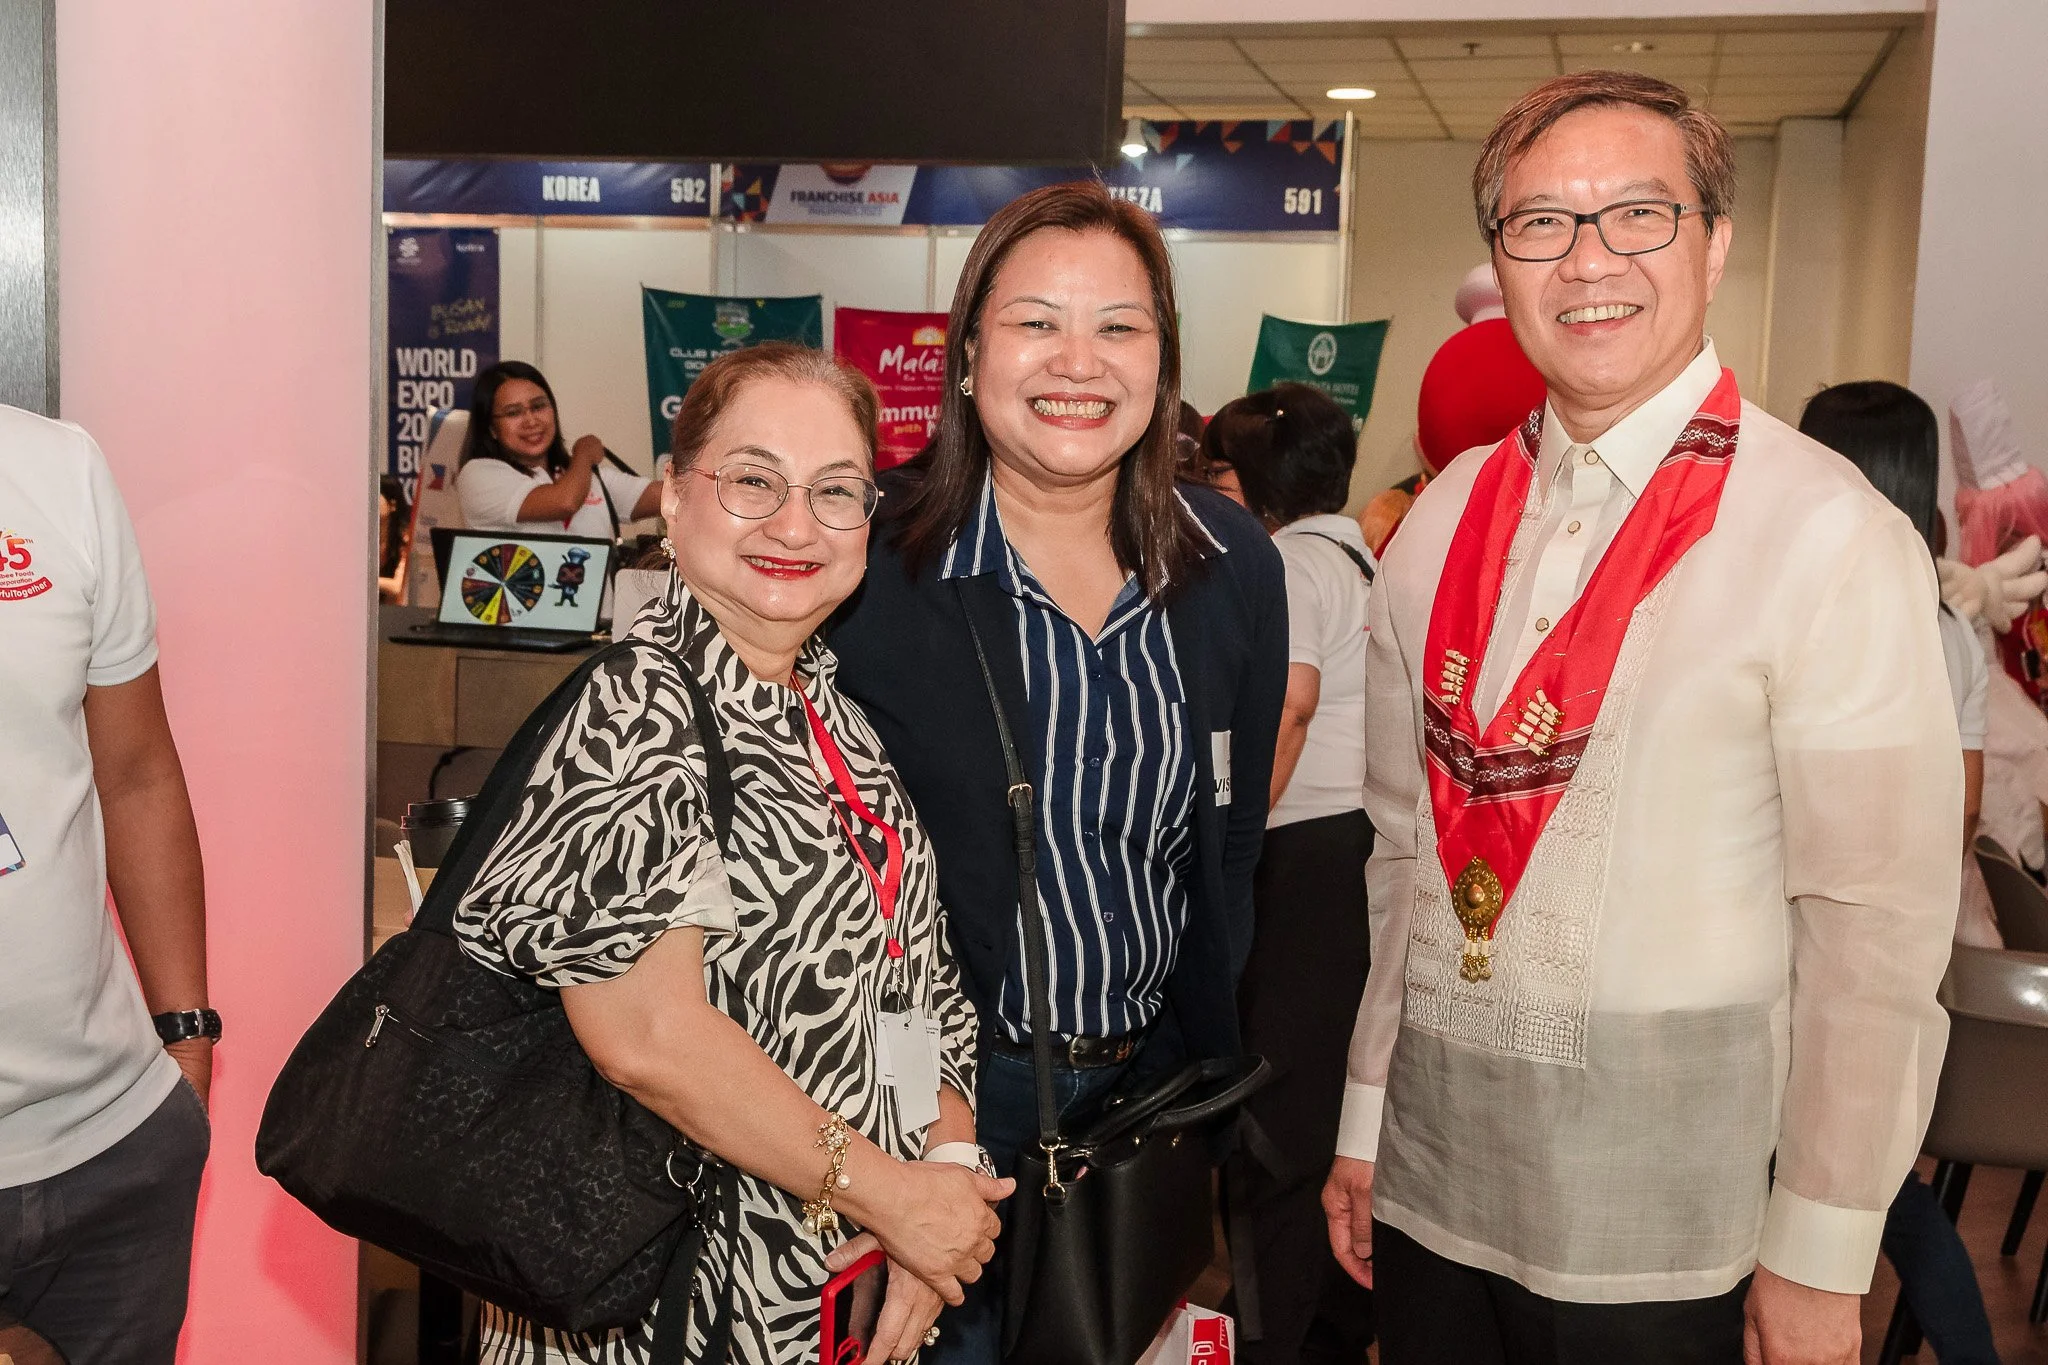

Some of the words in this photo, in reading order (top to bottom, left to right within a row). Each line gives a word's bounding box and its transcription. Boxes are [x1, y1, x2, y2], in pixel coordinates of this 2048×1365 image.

[542, 175, 600, 202] KOREA
[670, 177, 705, 203] 592
[791, 191, 864, 204] FRANCHISE
[867, 191, 899, 204] ASIA
[1284, 187, 1322, 215] 591
[396, 347, 478, 379] WORLD
[669, 346, 708, 359] CLUB
[879, 344, 939, 375] Mala
[397, 380, 455, 410] EXPO
[660, 395, 683, 420] G
[878, 404, 938, 423] mmu
[397, 412, 429, 443] 20
